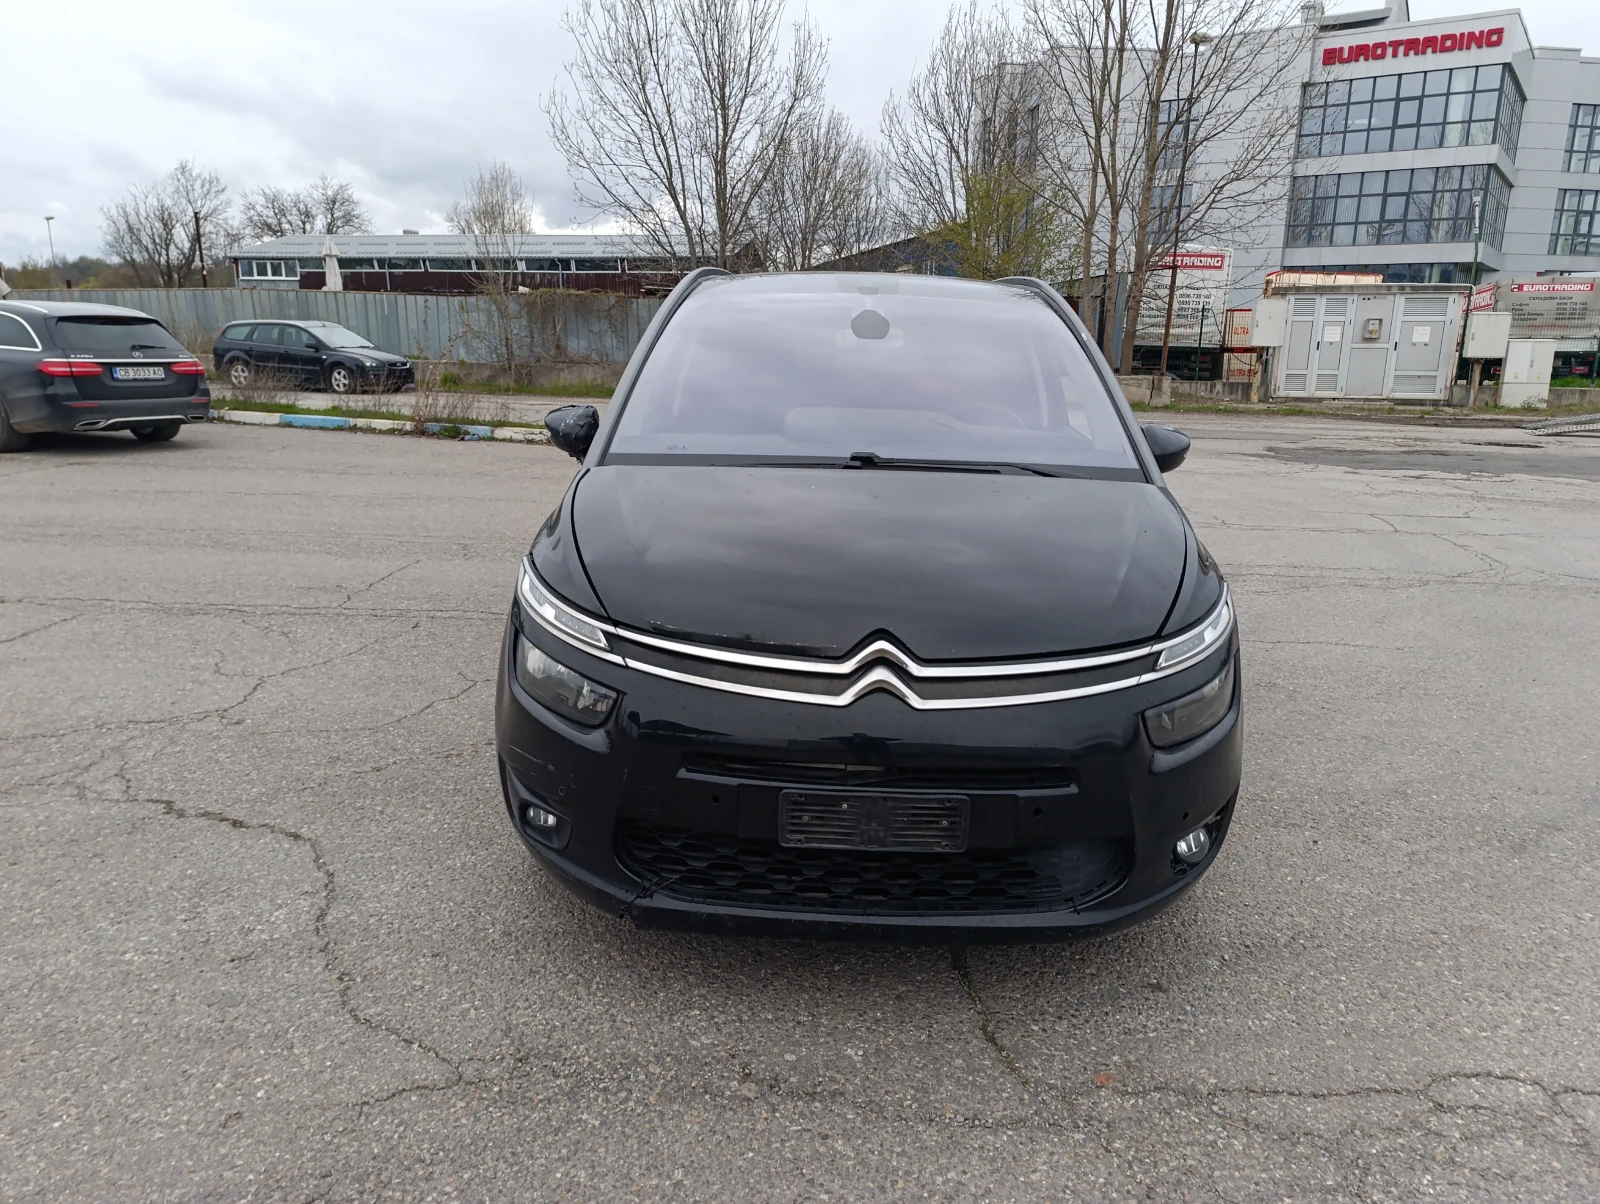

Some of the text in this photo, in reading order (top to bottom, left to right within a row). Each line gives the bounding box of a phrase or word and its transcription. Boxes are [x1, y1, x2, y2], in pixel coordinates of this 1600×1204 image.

[1322, 27, 1504, 66] EUROTRADING
[1234, 327, 1249, 335] ULTRA
[131, 368, 151, 377] 3033
